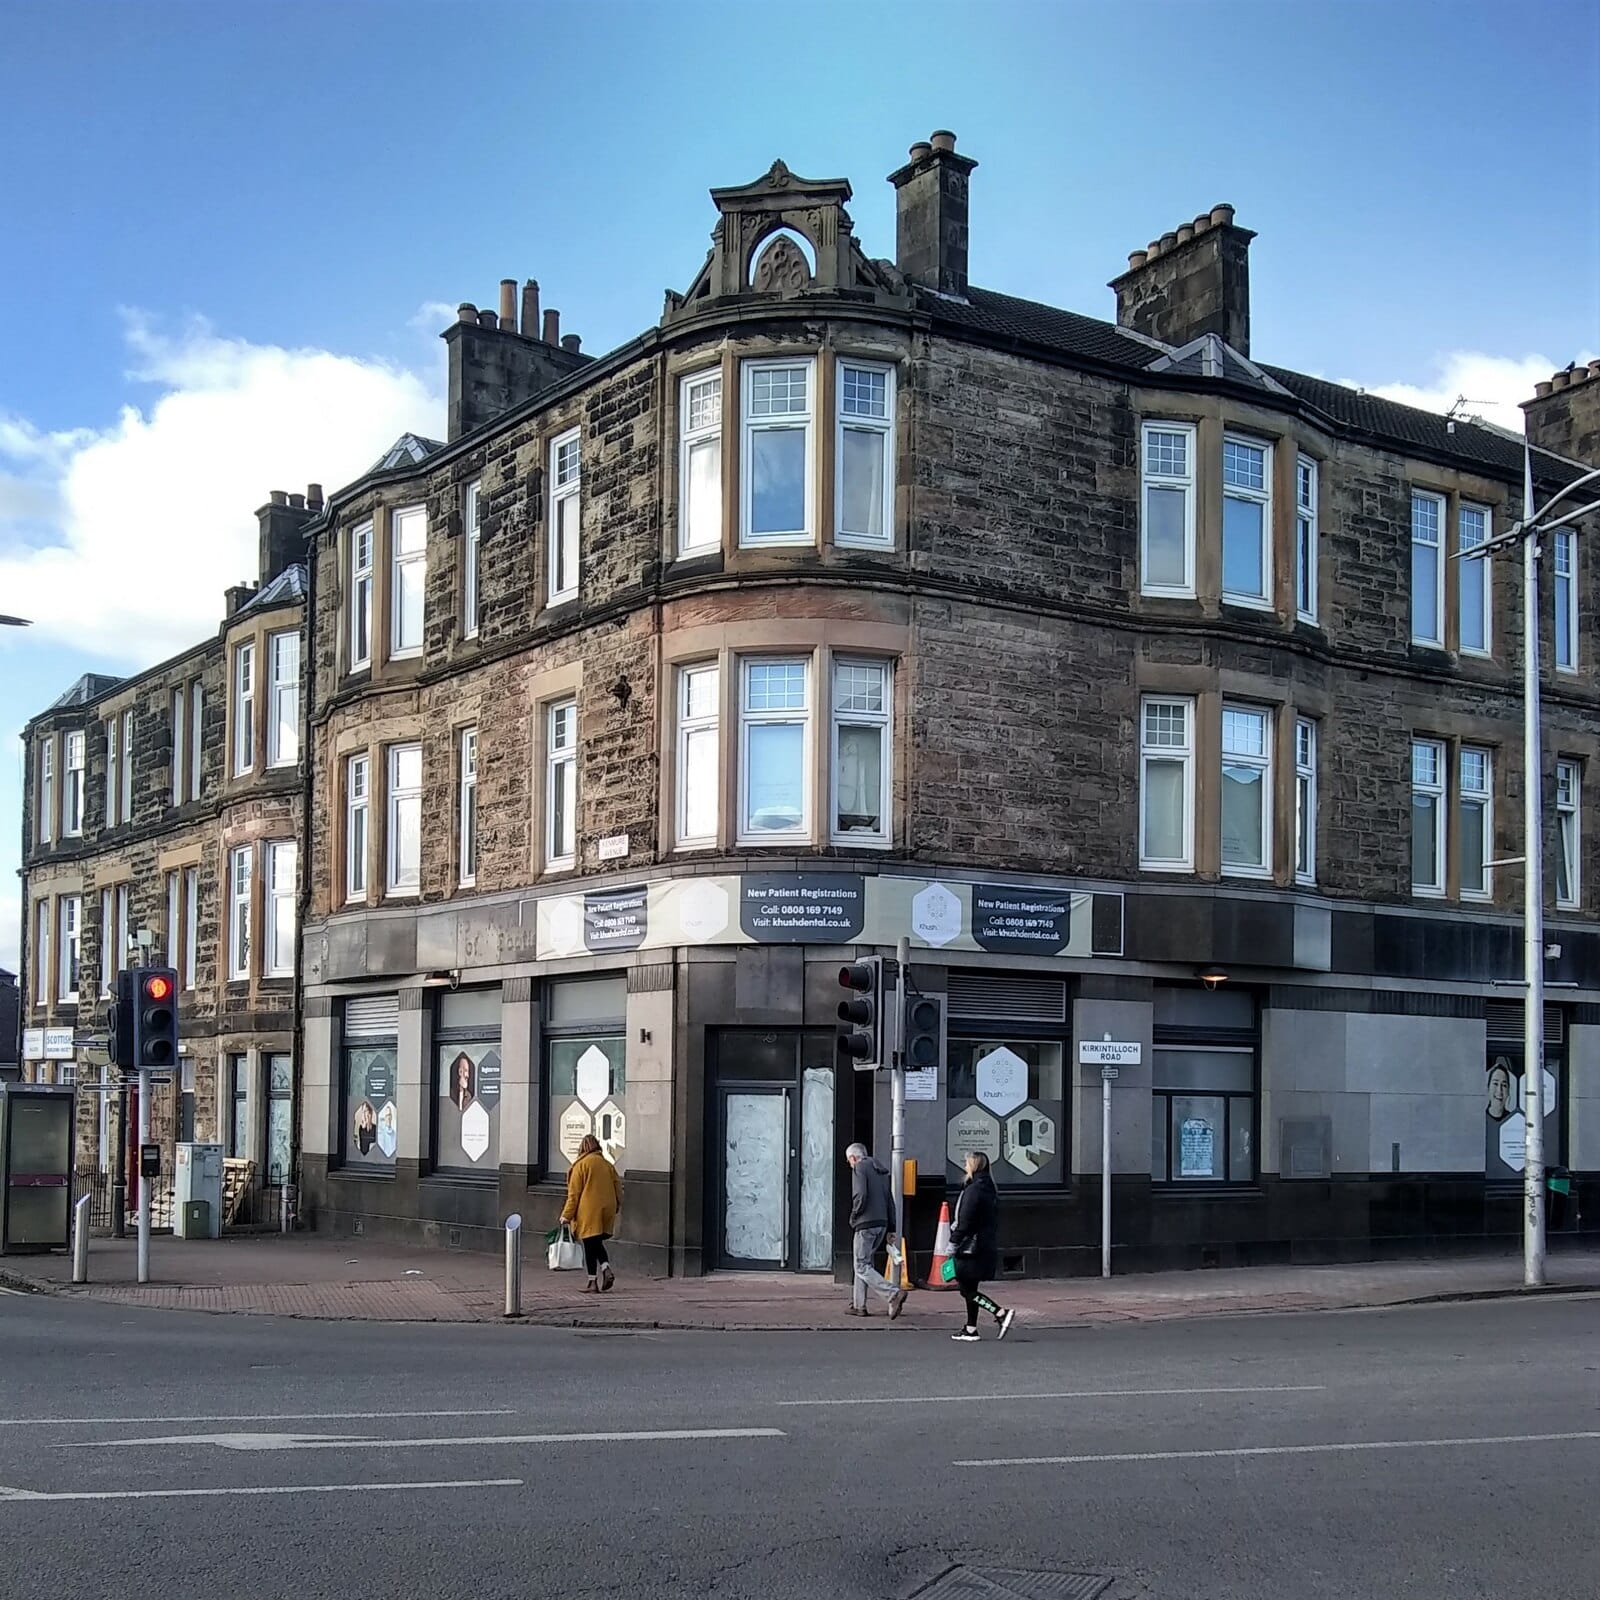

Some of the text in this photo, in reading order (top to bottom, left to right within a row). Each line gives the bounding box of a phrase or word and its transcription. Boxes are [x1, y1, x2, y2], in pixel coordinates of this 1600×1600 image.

[748, 889, 857, 899] New Patient Registrations
[761, 905, 843, 915] Call: 0808 169 7149
[978, 899, 1065, 913] New Patient Registrations
[752, 917, 851, 928] Visit: khushdental.co.uk
[1005, 917, 1023, 927] 0808
[999, 929, 1060, 941] khushdental.co.uk
[1082, 1044, 1138, 1054] KIRKINTILLOCH
[1100, 1053, 1122, 1062] ROAD
